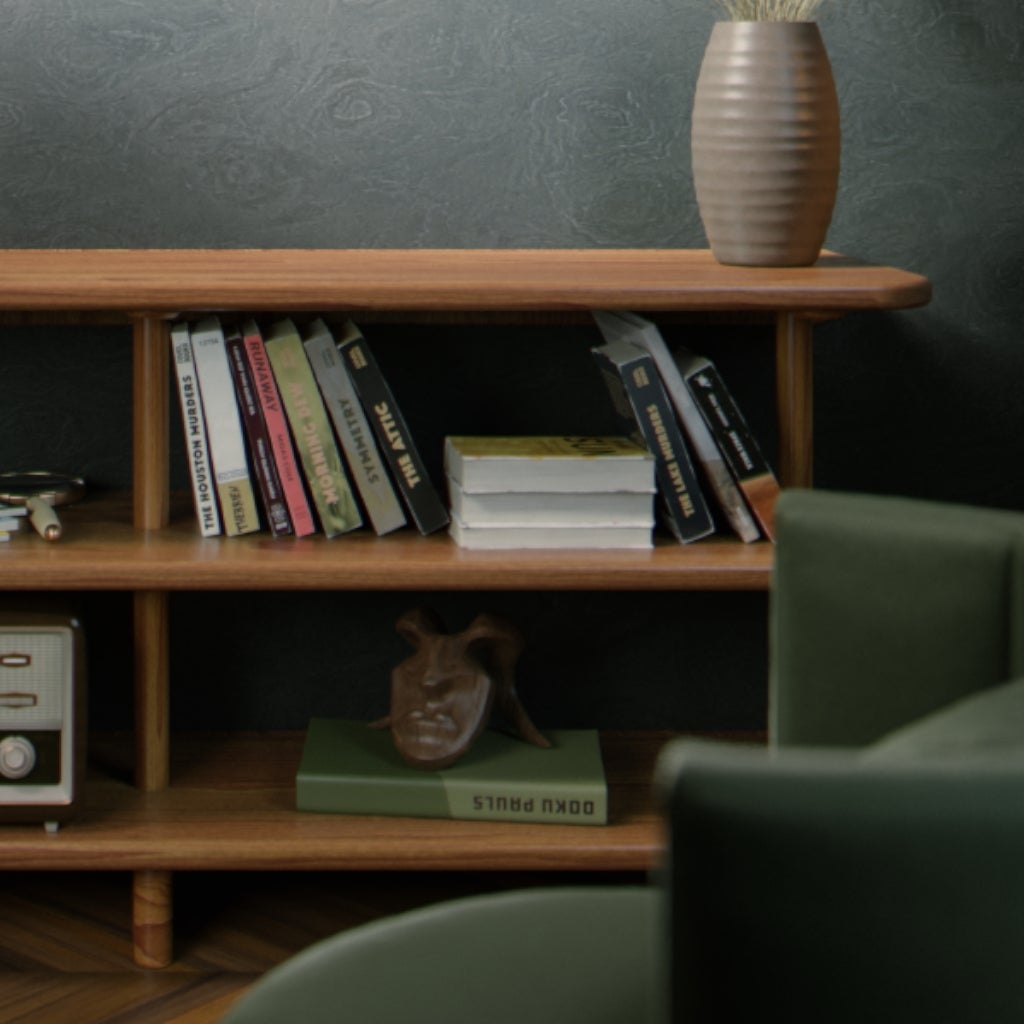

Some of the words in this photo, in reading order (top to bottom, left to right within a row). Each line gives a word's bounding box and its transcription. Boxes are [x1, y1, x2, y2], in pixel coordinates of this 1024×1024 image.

[249, 341, 278, 412] RUNAWAY
[289, 382, 313, 419] DEW
[183, 375, 200, 435] MURDERS
[374, 401, 407, 451] ATTIC
[339, 399, 379, 484] SYMMETRY
[646, 404, 675, 462] MURDERS
[193, 440, 209, 503] HOUSTON
[303, 422, 339, 504] MORNING
[397, 454, 422, 489] THE
[665, 461, 687, 493] LAKE
[203, 504, 215, 530] THE
[678, 494, 695, 519] THE
[473, 795, 534, 813] PAULS
